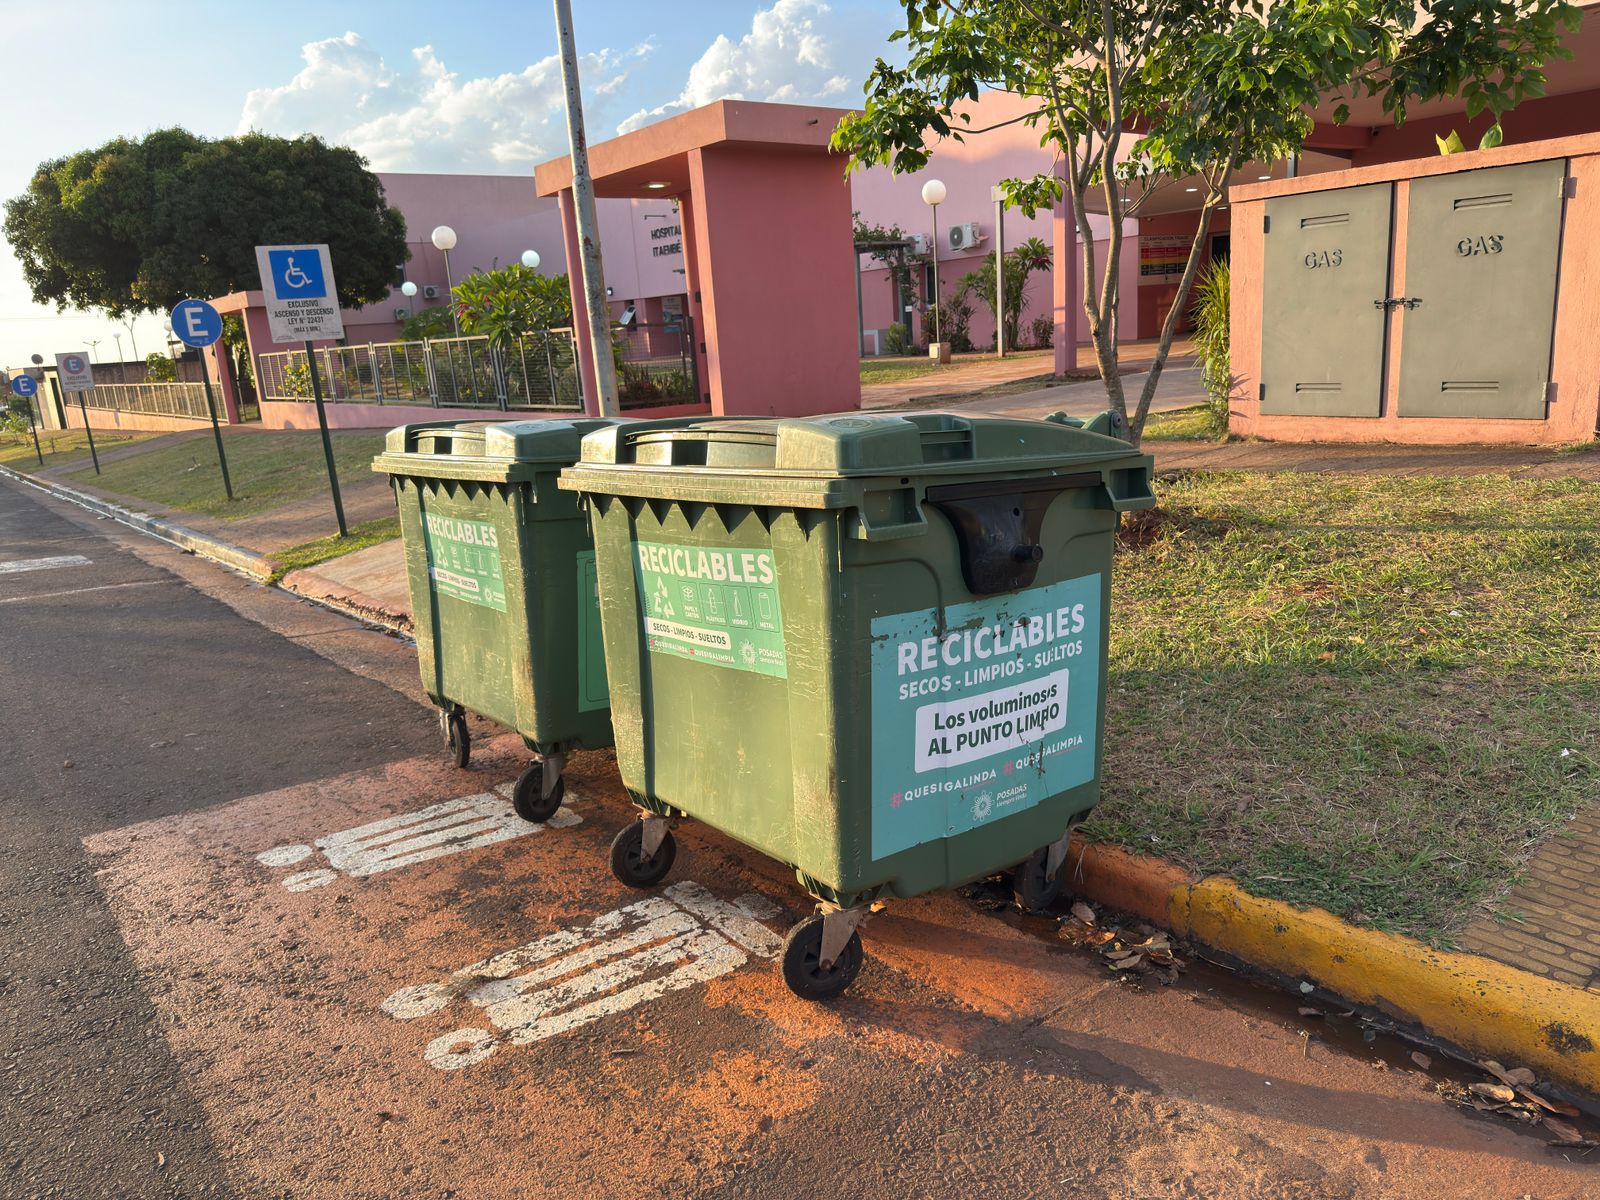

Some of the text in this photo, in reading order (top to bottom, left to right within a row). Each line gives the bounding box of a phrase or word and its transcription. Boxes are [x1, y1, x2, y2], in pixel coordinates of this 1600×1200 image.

[1456, 235, 1504, 257] GAS
[1304, 249, 1343, 269] GAS
[274, 310, 300, 318] ASCENSO
[306, 308, 334, 316] DESCENSO
[287, 300, 319, 308] EXCLUSIVO
[184, 306, 209, 337] E
[307, 316, 324, 324] 22431
[69, 359, 80, 371] E
[18, 378, 31, 393] E
[426, 514, 499, 549] RECICLABLES
[637, 544, 774, 585] RECICLABLES
[653, 622, 670, 633] SECOS
[673, 626, 695, 640] LIMPIOS
[698, 632, 727, 645] SUELTOS
[897, 603, 1085, 676] RECICLABLES
[759, 648, 783, 659] POSADAS
[899, 675, 951, 700] SECOS
[964, 658, 1024, 687] LIMPIOS
[935, 711, 965, 731] Los
[928, 736, 952, 757] AL
[956, 720, 1013, 751] PUNTO
[996, 783, 1027, 801] POSADAS
